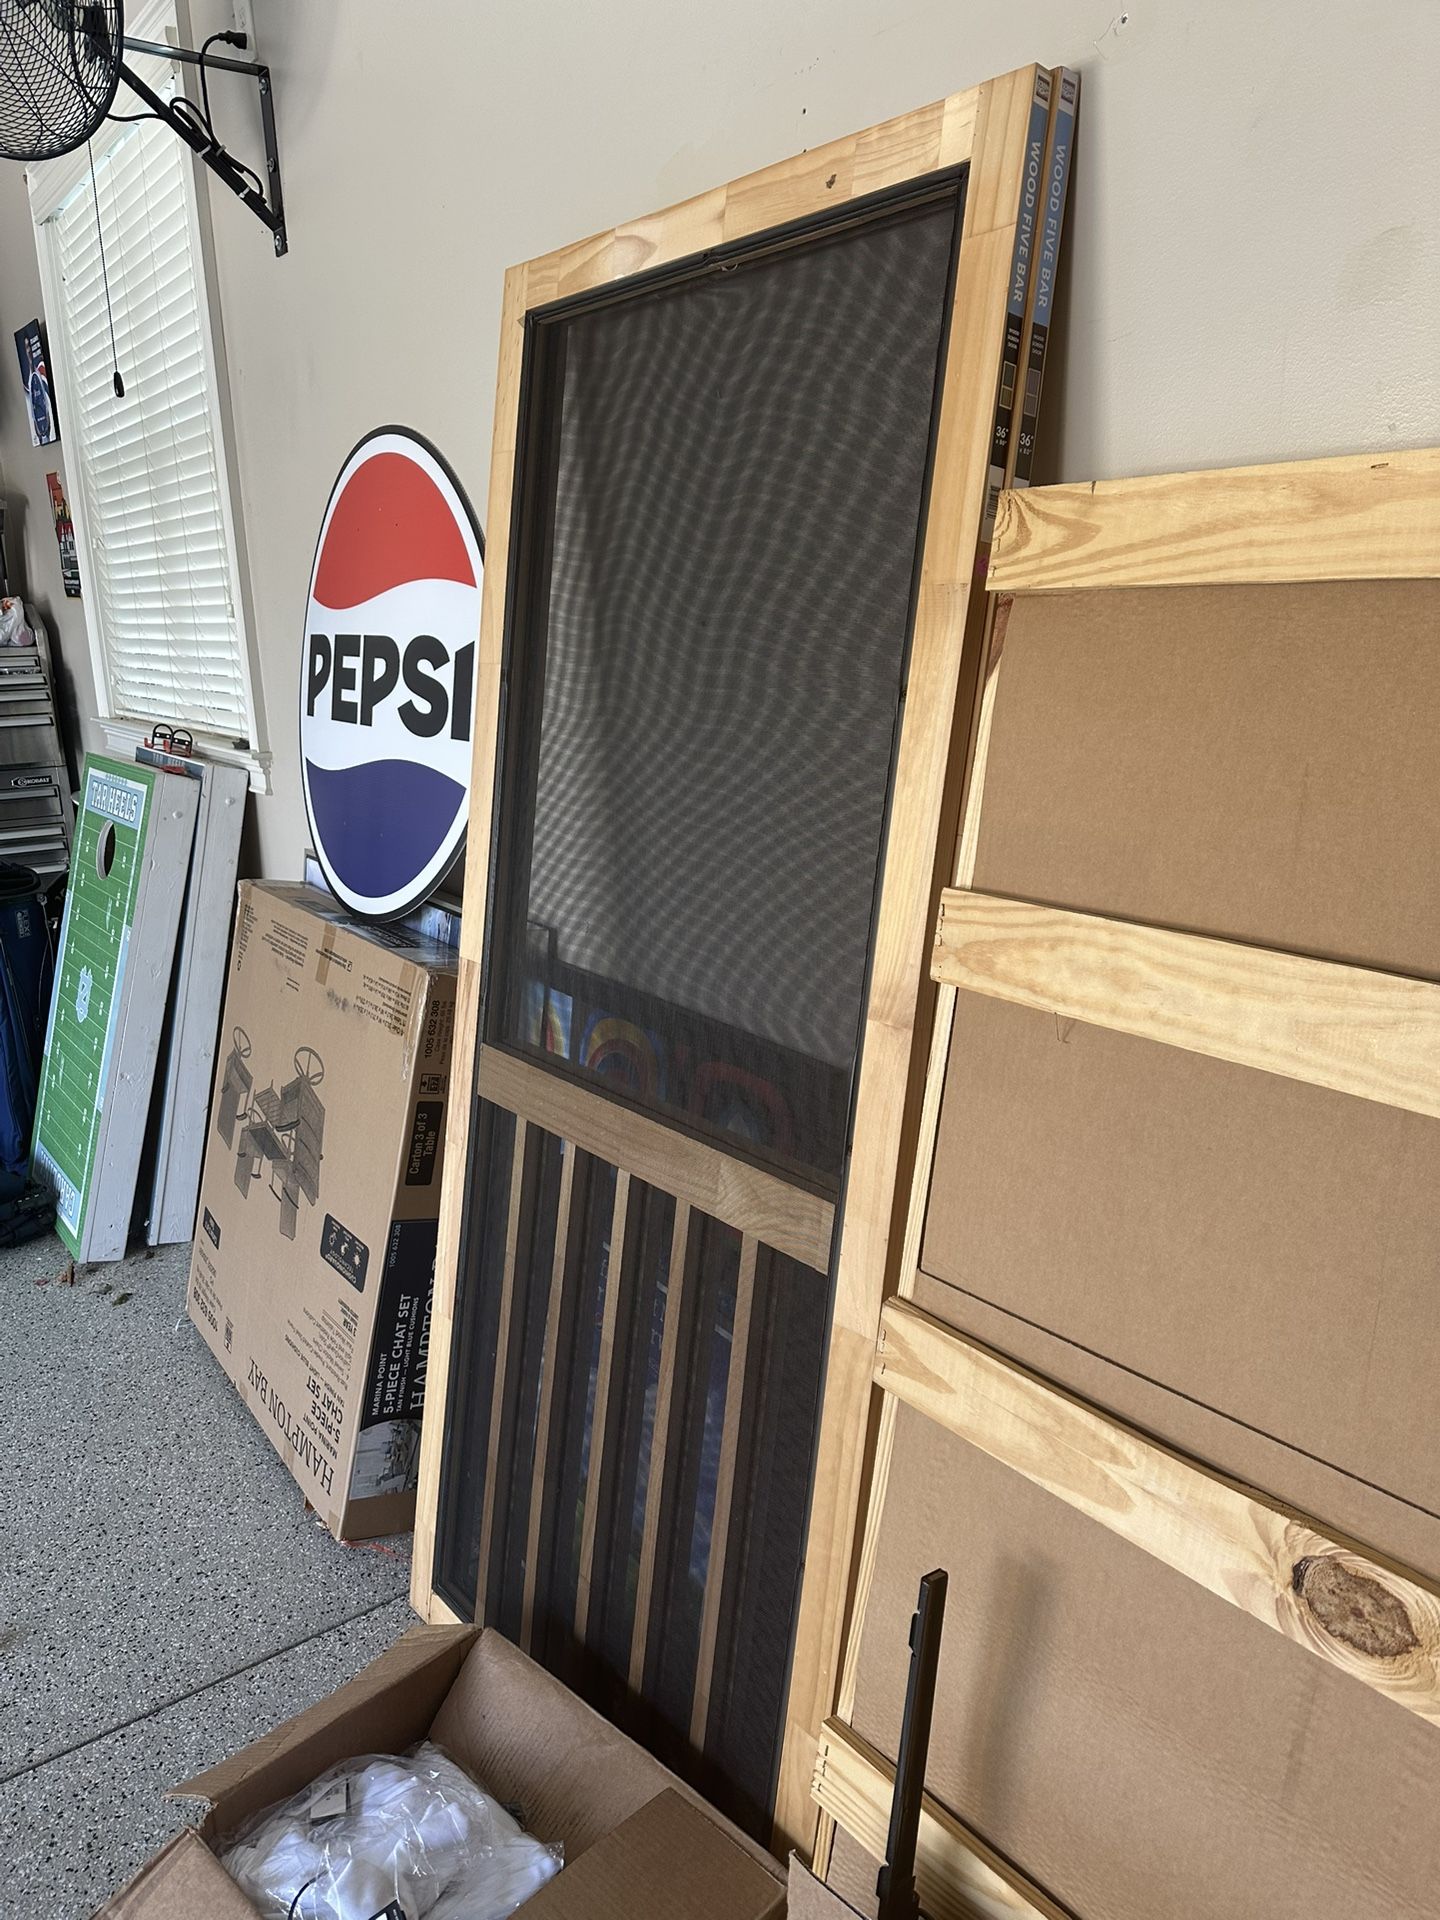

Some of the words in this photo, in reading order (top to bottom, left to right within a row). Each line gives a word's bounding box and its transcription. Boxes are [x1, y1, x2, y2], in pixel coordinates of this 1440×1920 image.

[1025, 142, 1041, 208] WOOD
[1050, 145, 1066, 211] WOOD
[1019, 213, 1032, 258] FIVE
[1043, 218, 1057, 263] FIVE
[1013, 262, 1026, 302] BAR
[1038, 268, 1051, 307] BAR
[307, 634, 475, 742] PEPSI
[91, 780, 108, 812] TAR
[107, 786, 138, 823] HEELS
[427, 1018, 437, 1035] 632
[430, 1000, 440, 1017] 308
[424, 1037, 434, 1058] 1005
[409, 1142, 422, 1173] Carton
[416, 1121, 425, 1131] of
[422, 1131, 435, 1156] Table
[398, 1294, 410, 1317] SET
[392, 1322, 406, 1358] CHAT
[398, 1376, 406, 1397] FINISH
[409, 1297, 418, 1329] CUSHIONS
[247, 1358, 267, 1403] BAY
[306, 1375, 320, 1398] SET
[372, 1381, 382, 1415] MARINA
[377, 1353, 386, 1378] POINT
[383, 1363, 400, 1413] 5-PIECE
[302, 1414, 317, 1434] POINT
[311, 1400, 340, 1443] 5-PIECE
[321, 1393, 342, 1424] CHAT
[269, 1389, 333, 1494] HAMPTON
[318, 1432, 337, 1458] MARINA
